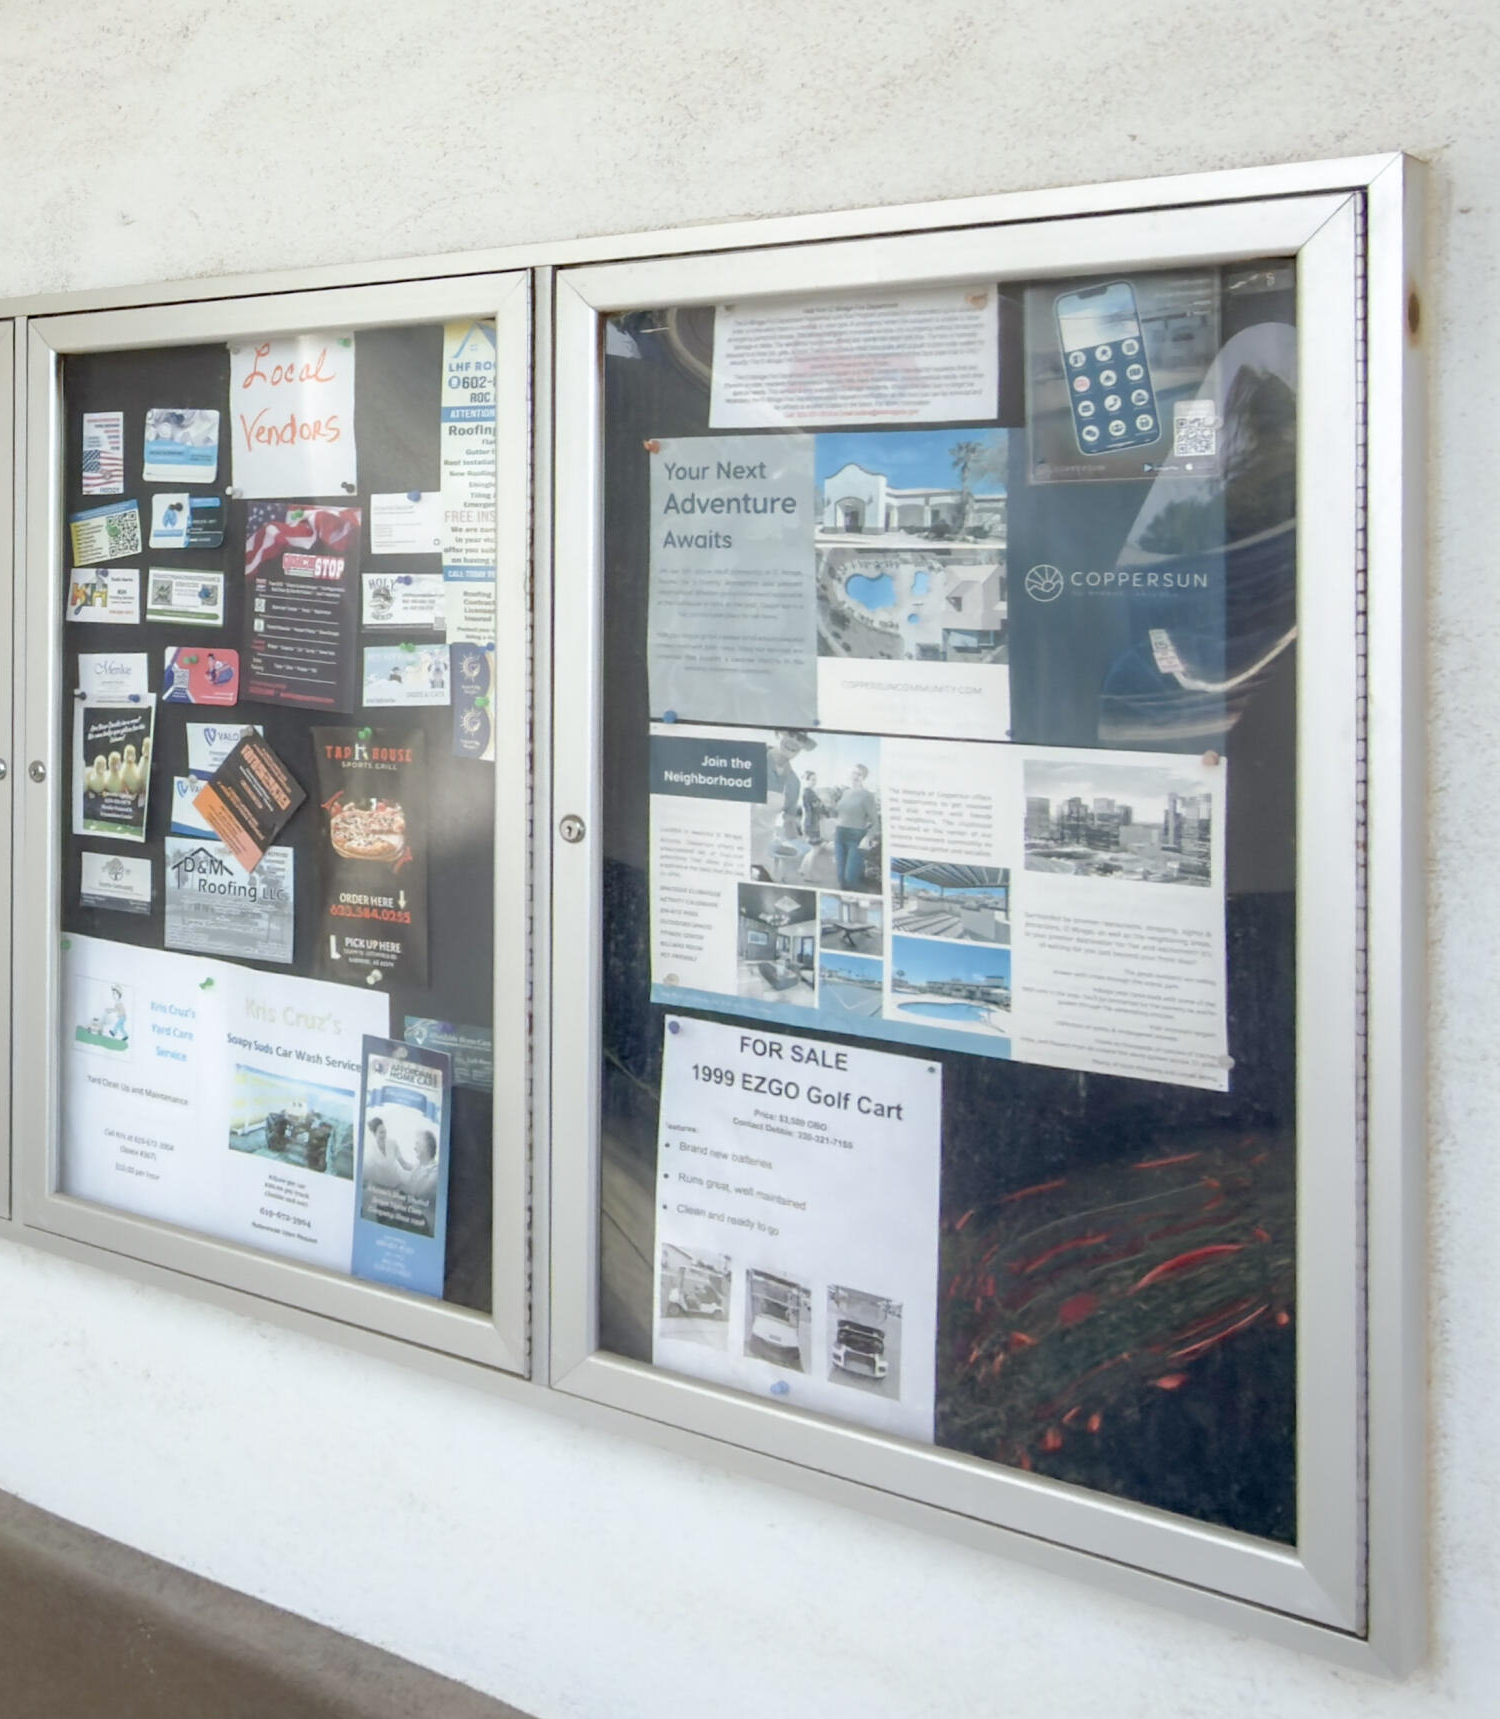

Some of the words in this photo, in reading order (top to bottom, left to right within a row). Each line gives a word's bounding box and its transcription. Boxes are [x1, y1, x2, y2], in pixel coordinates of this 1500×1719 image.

[242, 342, 336, 389] Local
[475, 361, 496, 371] RO
[240, 408, 341, 451] Vendors
[664, 461, 710, 482] Your
[715, 461, 767, 480] Next
[663, 492, 797, 516] Adventure
[444, 510, 474, 522] FREE
[663, 528, 733, 549] Awaits
[315, 558, 346, 578] STOP
[1070, 571, 1209, 588] COPPERSUN
[325, 745, 351, 759] TAP
[372, 747, 412, 762] HOUSE
[701, 756, 728, 769] Join
[732, 757, 752, 770] the
[342, 761, 372, 769] SPORTS
[375, 763, 397, 771] GRILL
[664, 770, 752, 789] Neighborhood
[198, 878, 258, 903] Roofing
[262, 887, 285, 901] LLC
[339, 892, 369, 905] ORDER
[370, 896, 394, 908] HERE
[344, 936, 366, 949] PICK
[366, 939, 379, 950] UP
[379, 940, 402, 954] HERE
[244, 996, 278, 1024] Kris
[152, 1023, 171, 1036] Yard
[172, 1026, 195, 1041] Care
[156, 1044, 188, 1062] Service
[227, 1032, 253, 1051] Soapy
[253, 1040, 274, 1055] Suds
[275, 1046, 294, 1059] Car
[295, 1049, 323, 1065] Wash
[325, 1056, 363, 1074] Service
[739, 1036, 783, 1060] FOR
[790, 1045, 848, 1071] SALE
[692, 1064, 735, 1087] 1999
[741, 1073, 800, 1099] EZGO
[806, 1086, 851, 1110] Golf
[857, 1096, 904, 1121] Cart
[732, 1117, 764, 1131] Contact
[753, 1108, 777, 1121] Price:
[806, 1120, 828, 1132] OBO
[679, 1141, 708, 1156] Brand
[709, 1149, 729, 1160] new
[731, 1153, 773, 1170] batteries
[678, 1172, 704, 1186] Runs
[705, 1178, 731, 1193] great,
[734, 1186, 754, 1197] well
[755, 1190, 806, 1211] maintained
[676, 1203, 706, 1217] Clean
[707, 1210, 725, 1222] and
[726, 1216, 755, 1231] ready
[756, 1221, 767, 1232] to
[767, 1225, 779, 1236] go
